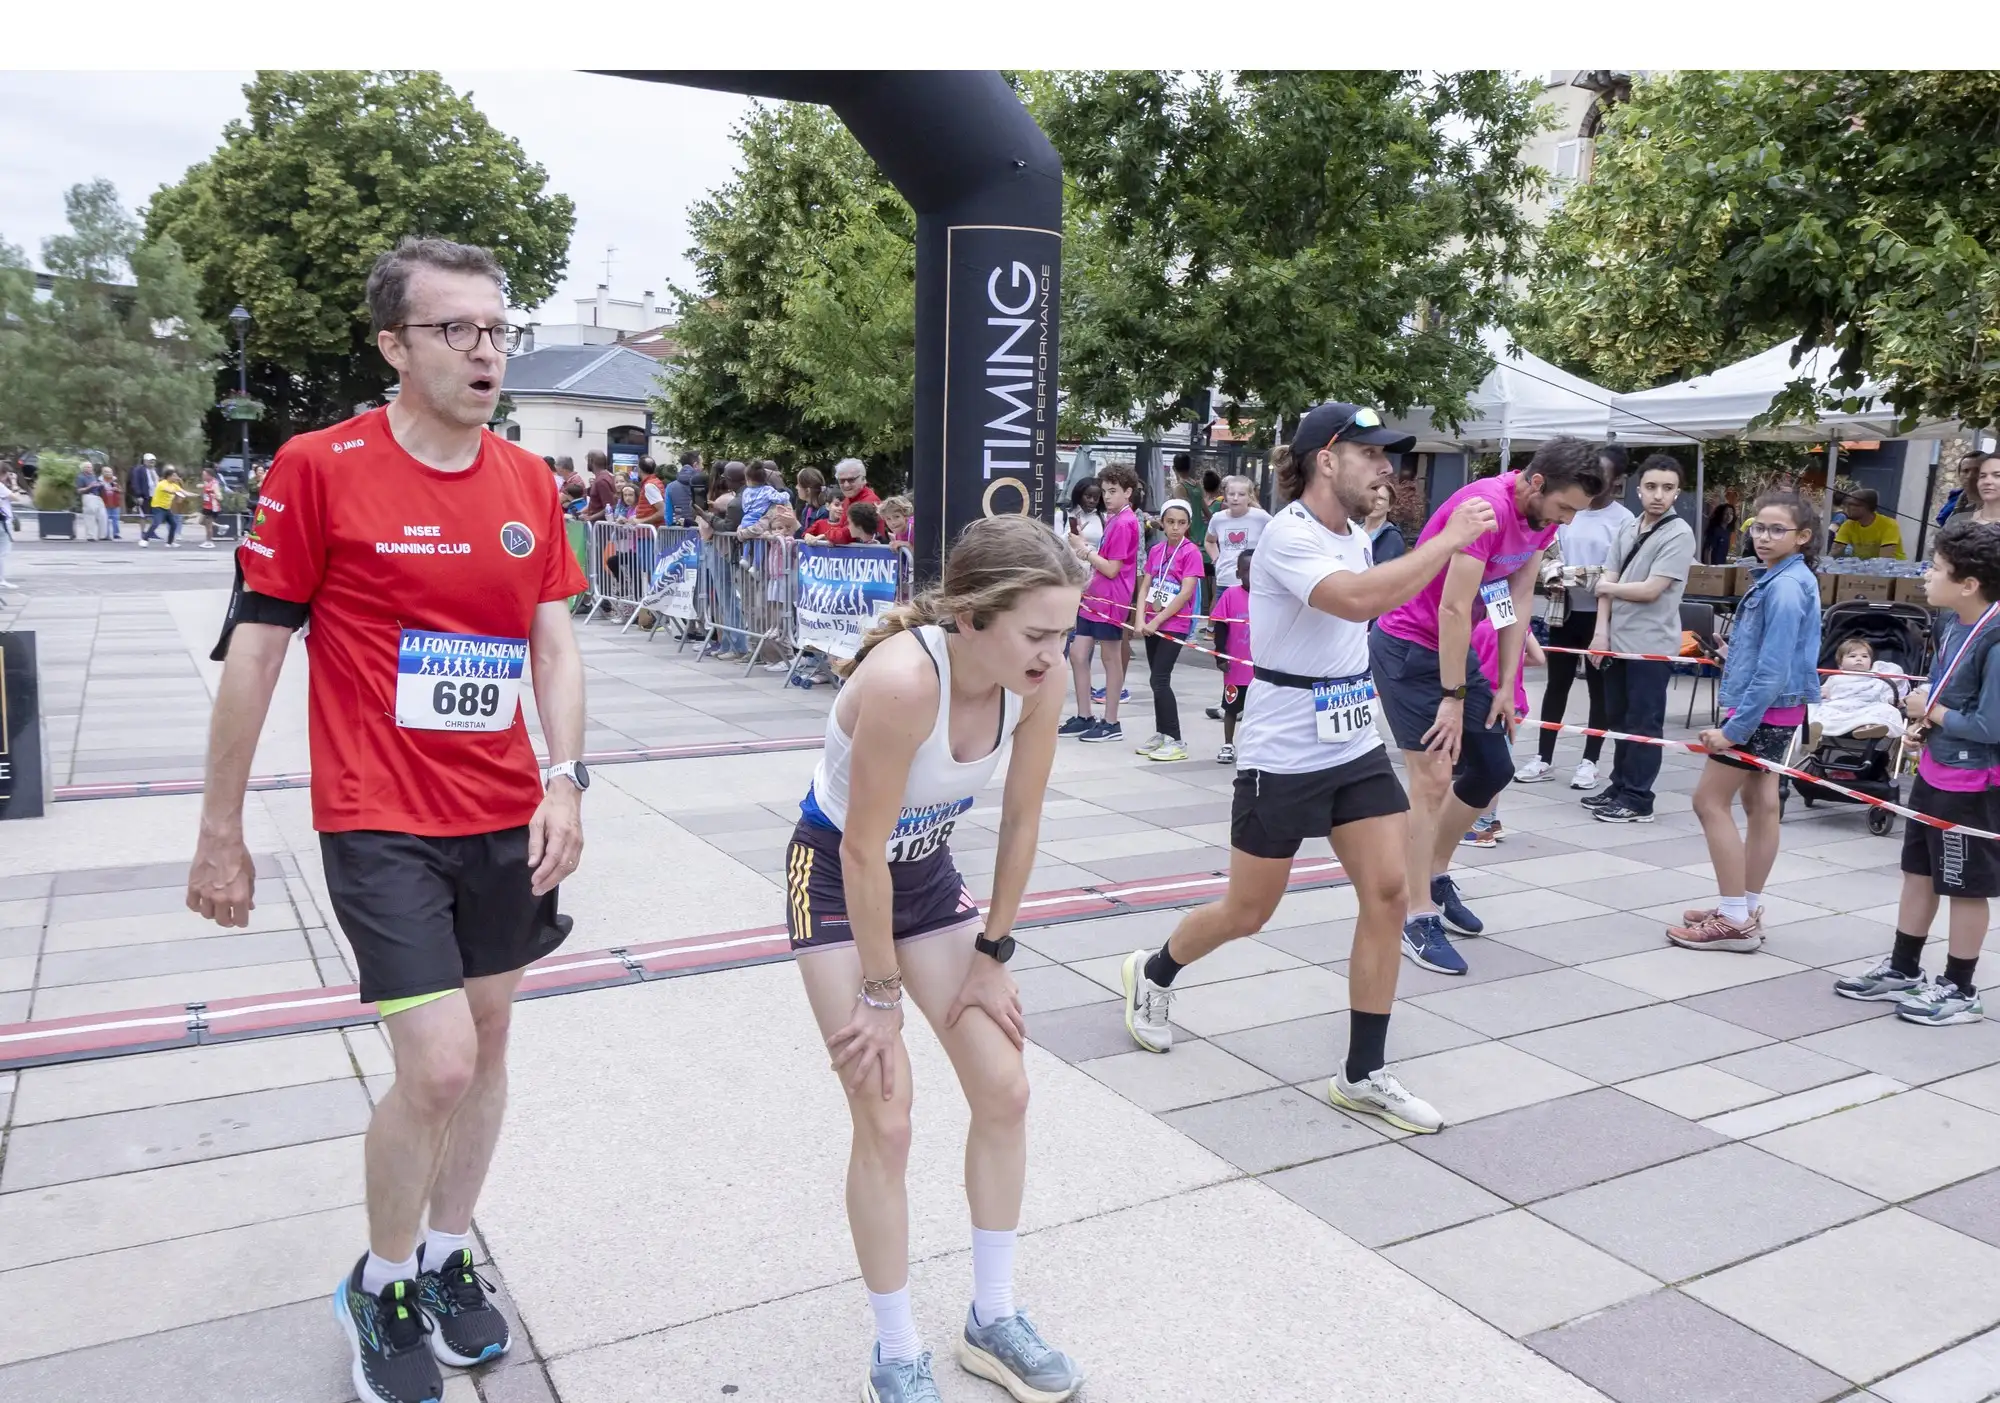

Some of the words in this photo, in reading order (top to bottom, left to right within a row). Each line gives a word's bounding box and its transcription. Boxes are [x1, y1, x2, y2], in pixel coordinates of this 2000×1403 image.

[1037, 264, 1051, 422] PERFORMANCE
[1036, 429, 1045, 456] DE
[403, 525, 441, 537] INSEE
[375, 542, 435, 554] RUNNING
[437, 543, 471, 554] CLUB
[832, 619, 845, 632] 15
[401, 636, 420, 652] LA
[422, 637, 527, 660] FONTENAISIENNE
[432, 680, 500, 717] 689
[1314, 686, 1326, 698] LA
[444, 720, 487, 730] CHRISTIAN
[1329, 704, 1372, 734] 1105
[891, 821, 956, 863] 1038
